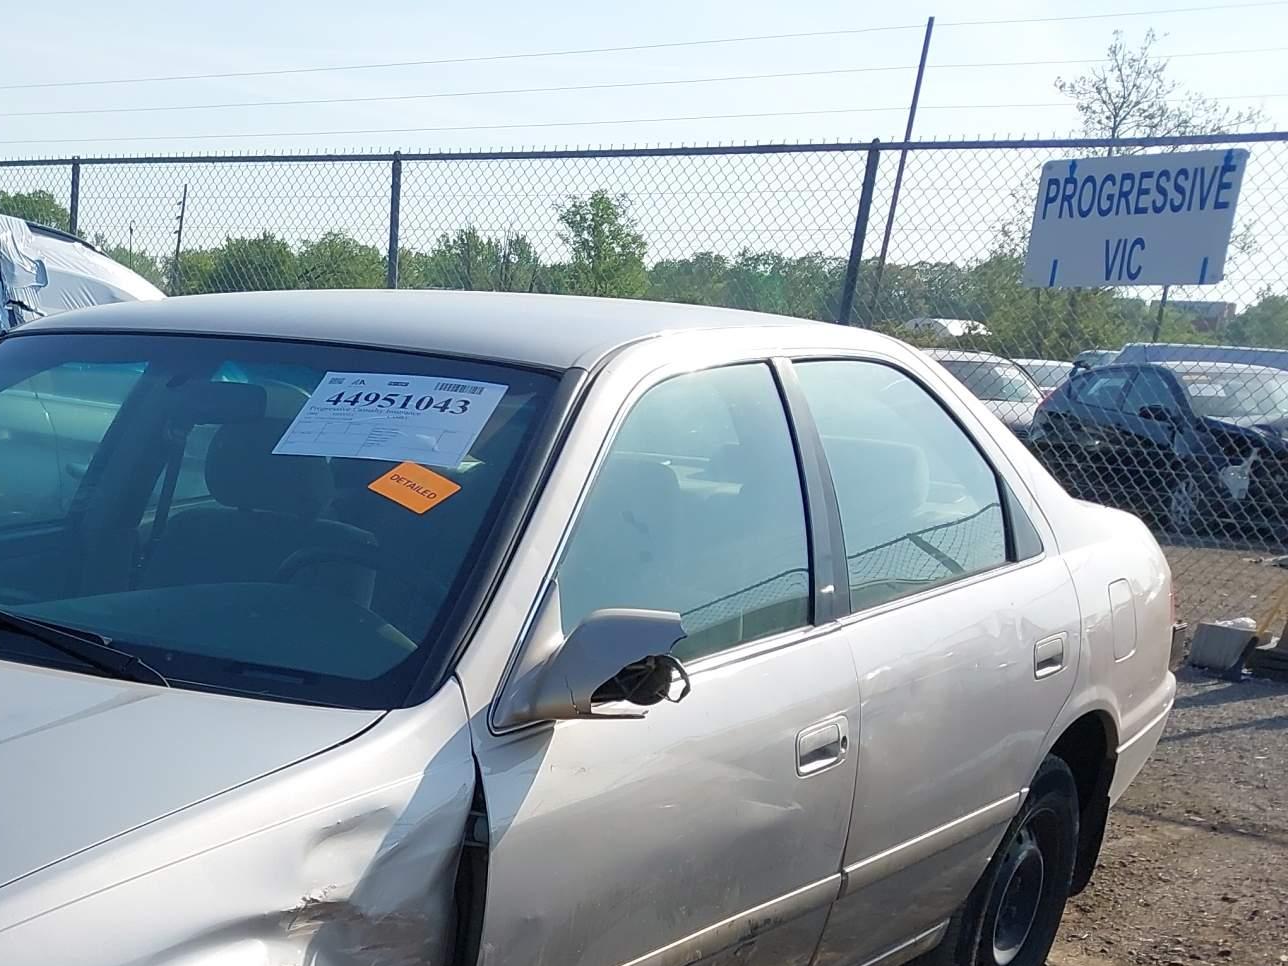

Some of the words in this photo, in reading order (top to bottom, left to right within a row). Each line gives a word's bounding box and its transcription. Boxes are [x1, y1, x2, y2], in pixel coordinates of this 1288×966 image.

[1042, 164, 1236, 219] PROGRESSIVE
[1105, 237, 1145, 281] VIC
[326, 390, 471, 415] 44951043
[390, 473, 438, 500] DETAILED
